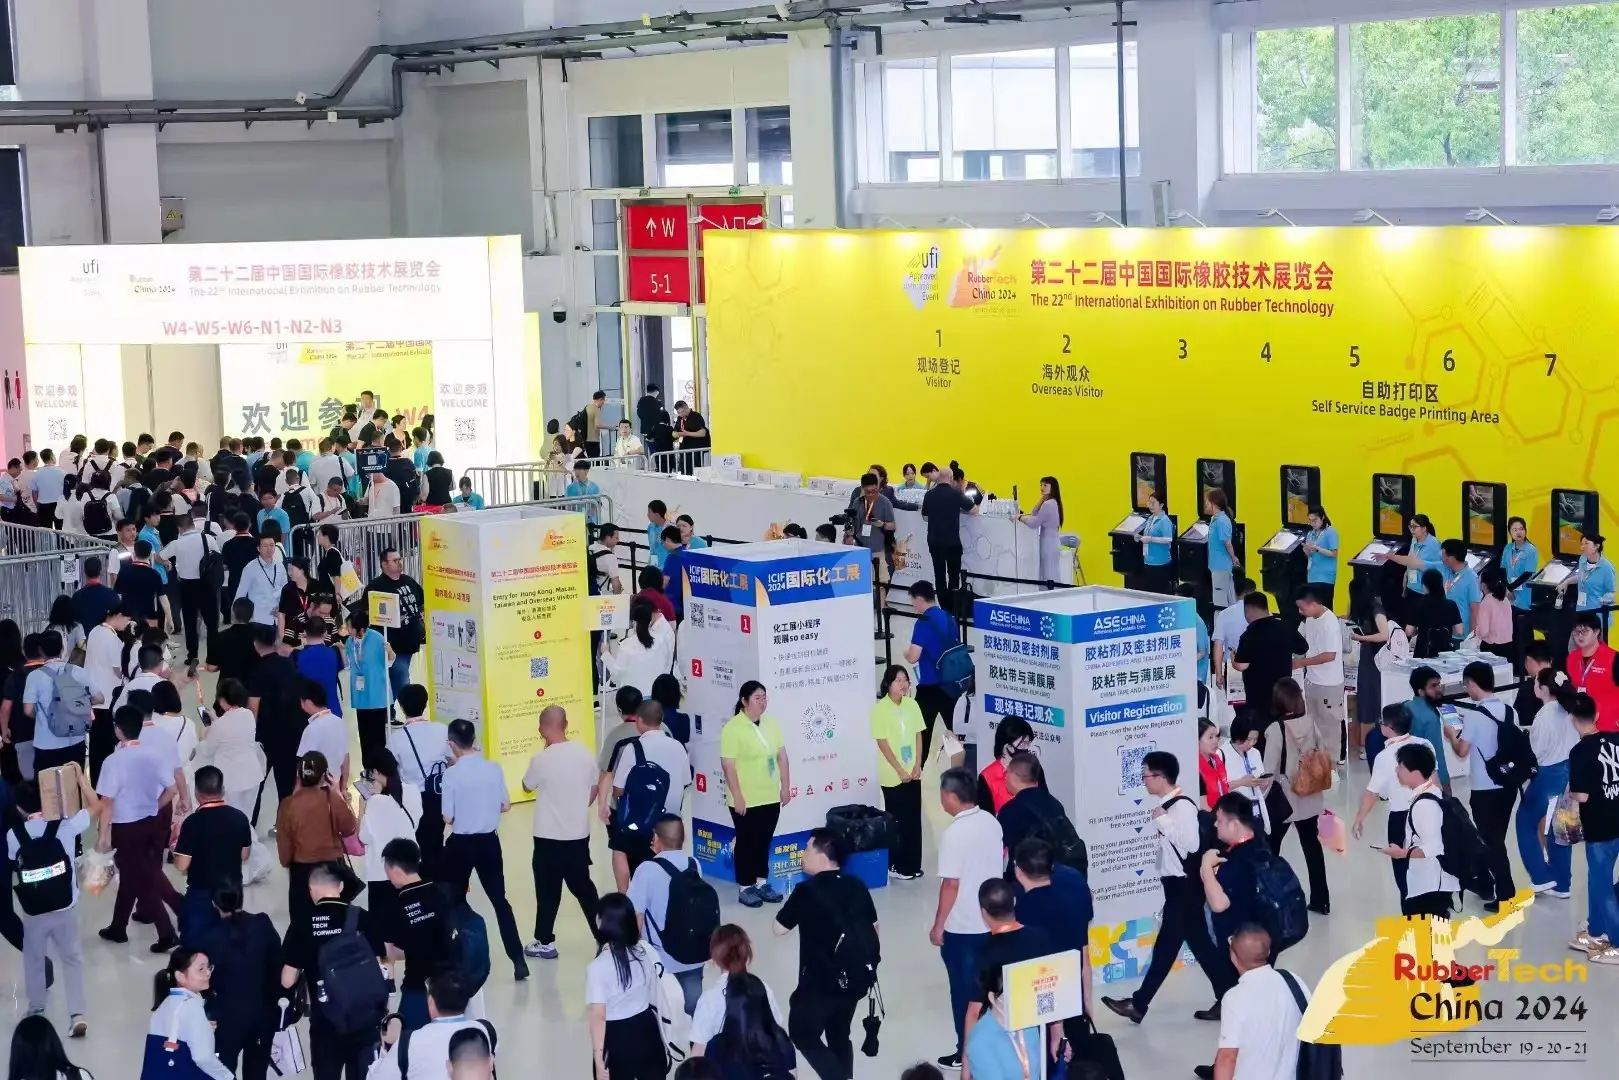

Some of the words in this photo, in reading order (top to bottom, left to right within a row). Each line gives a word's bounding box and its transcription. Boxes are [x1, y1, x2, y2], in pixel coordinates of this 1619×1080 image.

[662, 218, 676, 238] W
[922, 247, 938, 268] ufi
[82, 259, 99, 274] ufi
[188, 260, 441, 282] 第二十二届中国国际橡胶技术展览会
[1031, 260, 1334, 290] 第二十二届中国国际橡胶技术展览会
[651, 274, 672, 294] 5-1
[909, 272, 937, 282] Approved
[922, 292, 939, 300] Event
[972, 288, 996, 299] China
[998, 289, 1016, 300] 2024
[1031, 294, 1049, 306] The
[1052, 292, 1072, 307] 22nd
[1075, 294, 1142, 308] International
[1146, 295, 1200, 310] Exhibition
[1203, 299, 1216, 311] on
[1221, 298, 1262, 312] Rubber
[1265, 299, 1334, 317] Technology
[163, 318, 343, 336] W4-W5-W6-N1-N2-N3
[935, 329, 942, 347] 1
[1062, 334, 1071, 354] 2
[1178, 339, 1188, 359] 3
[1260, 342, 1272, 363] 4
[1350, 346, 1361, 367] 5
[918, 357, 961, 374] 现场登记
[1443, 350, 1456, 372] 6
[1544, 353, 1557, 376] 7
[925, 376, 951, 388] Visitor
[1042, 364, 1090, 383] 海外观众
[34, 385, 77, 396] 欢迎参观
[440, 382, 488, 396] 欢迎参观
[1032, 383, 1072, 397] Overseas
[1075, 384, 1104, 398] Visitor
[1362, 380, 1439, 402] 自助打印区
[35, 400, 78, 408] WELCOME
[441, 398, 488, 408] WELCOME
[1312, 400, 1332, 412] Self
[1336, 401, 1375, 416] Service
[1379, 404, 1416, 420] Badge
[1420, 407, 1466, 424] Printing
[1470, 410, 1499, 424] Area
[690, 565, 700, 574] ICIF
[768, 572, 785, 583] ICIF
[786, 564, 860, 589] 国际化工展
[690, 575, 700, 583] 2024
[700, 568, 748, 590] 国际化工展
[768, 583, 785, 592] 2024
[773, 619, 820, 633] 化工展小程序
[800, 632, 818, 640] easy
[984, 635, 1059, 661] 胶粘剂及密封剂展
[1085, 635, 1181, 661] 胶粘剂及密封剂展
[1102, 659, 1129, 668] ADHESIVES
[1143, 654, 1168, 662] SEALANTS
[990, 665, 1055, 690] 胶粘带与薄膜展
[1092, 665, 1176, 690] 胶粘带与薄膜展
[995, 698, 1054, 724] 现场登记观众
[1090, 710, 1121, 723] Visitor
[1124, 700, 1182, 719] Registration
[1110, 728, 1121, 736] scan
[1133, 723, 1149, 731] above
[1150, 719, 1182, 728] Registration
[1115, 811, 1145, 820] information
[1119, 836, 1142, 846] passport
[1112, 864, 1127, 872] claim
[1118, 881, 1135, 890] badge
[1112, 891, 1135, 899] machine
[404, 902, 421, 911] THINK
[408, 909, 422, 918] TECH
[410, 912, 435, 924] FORWARD
[313, 928, 342, 936] FORWARD
